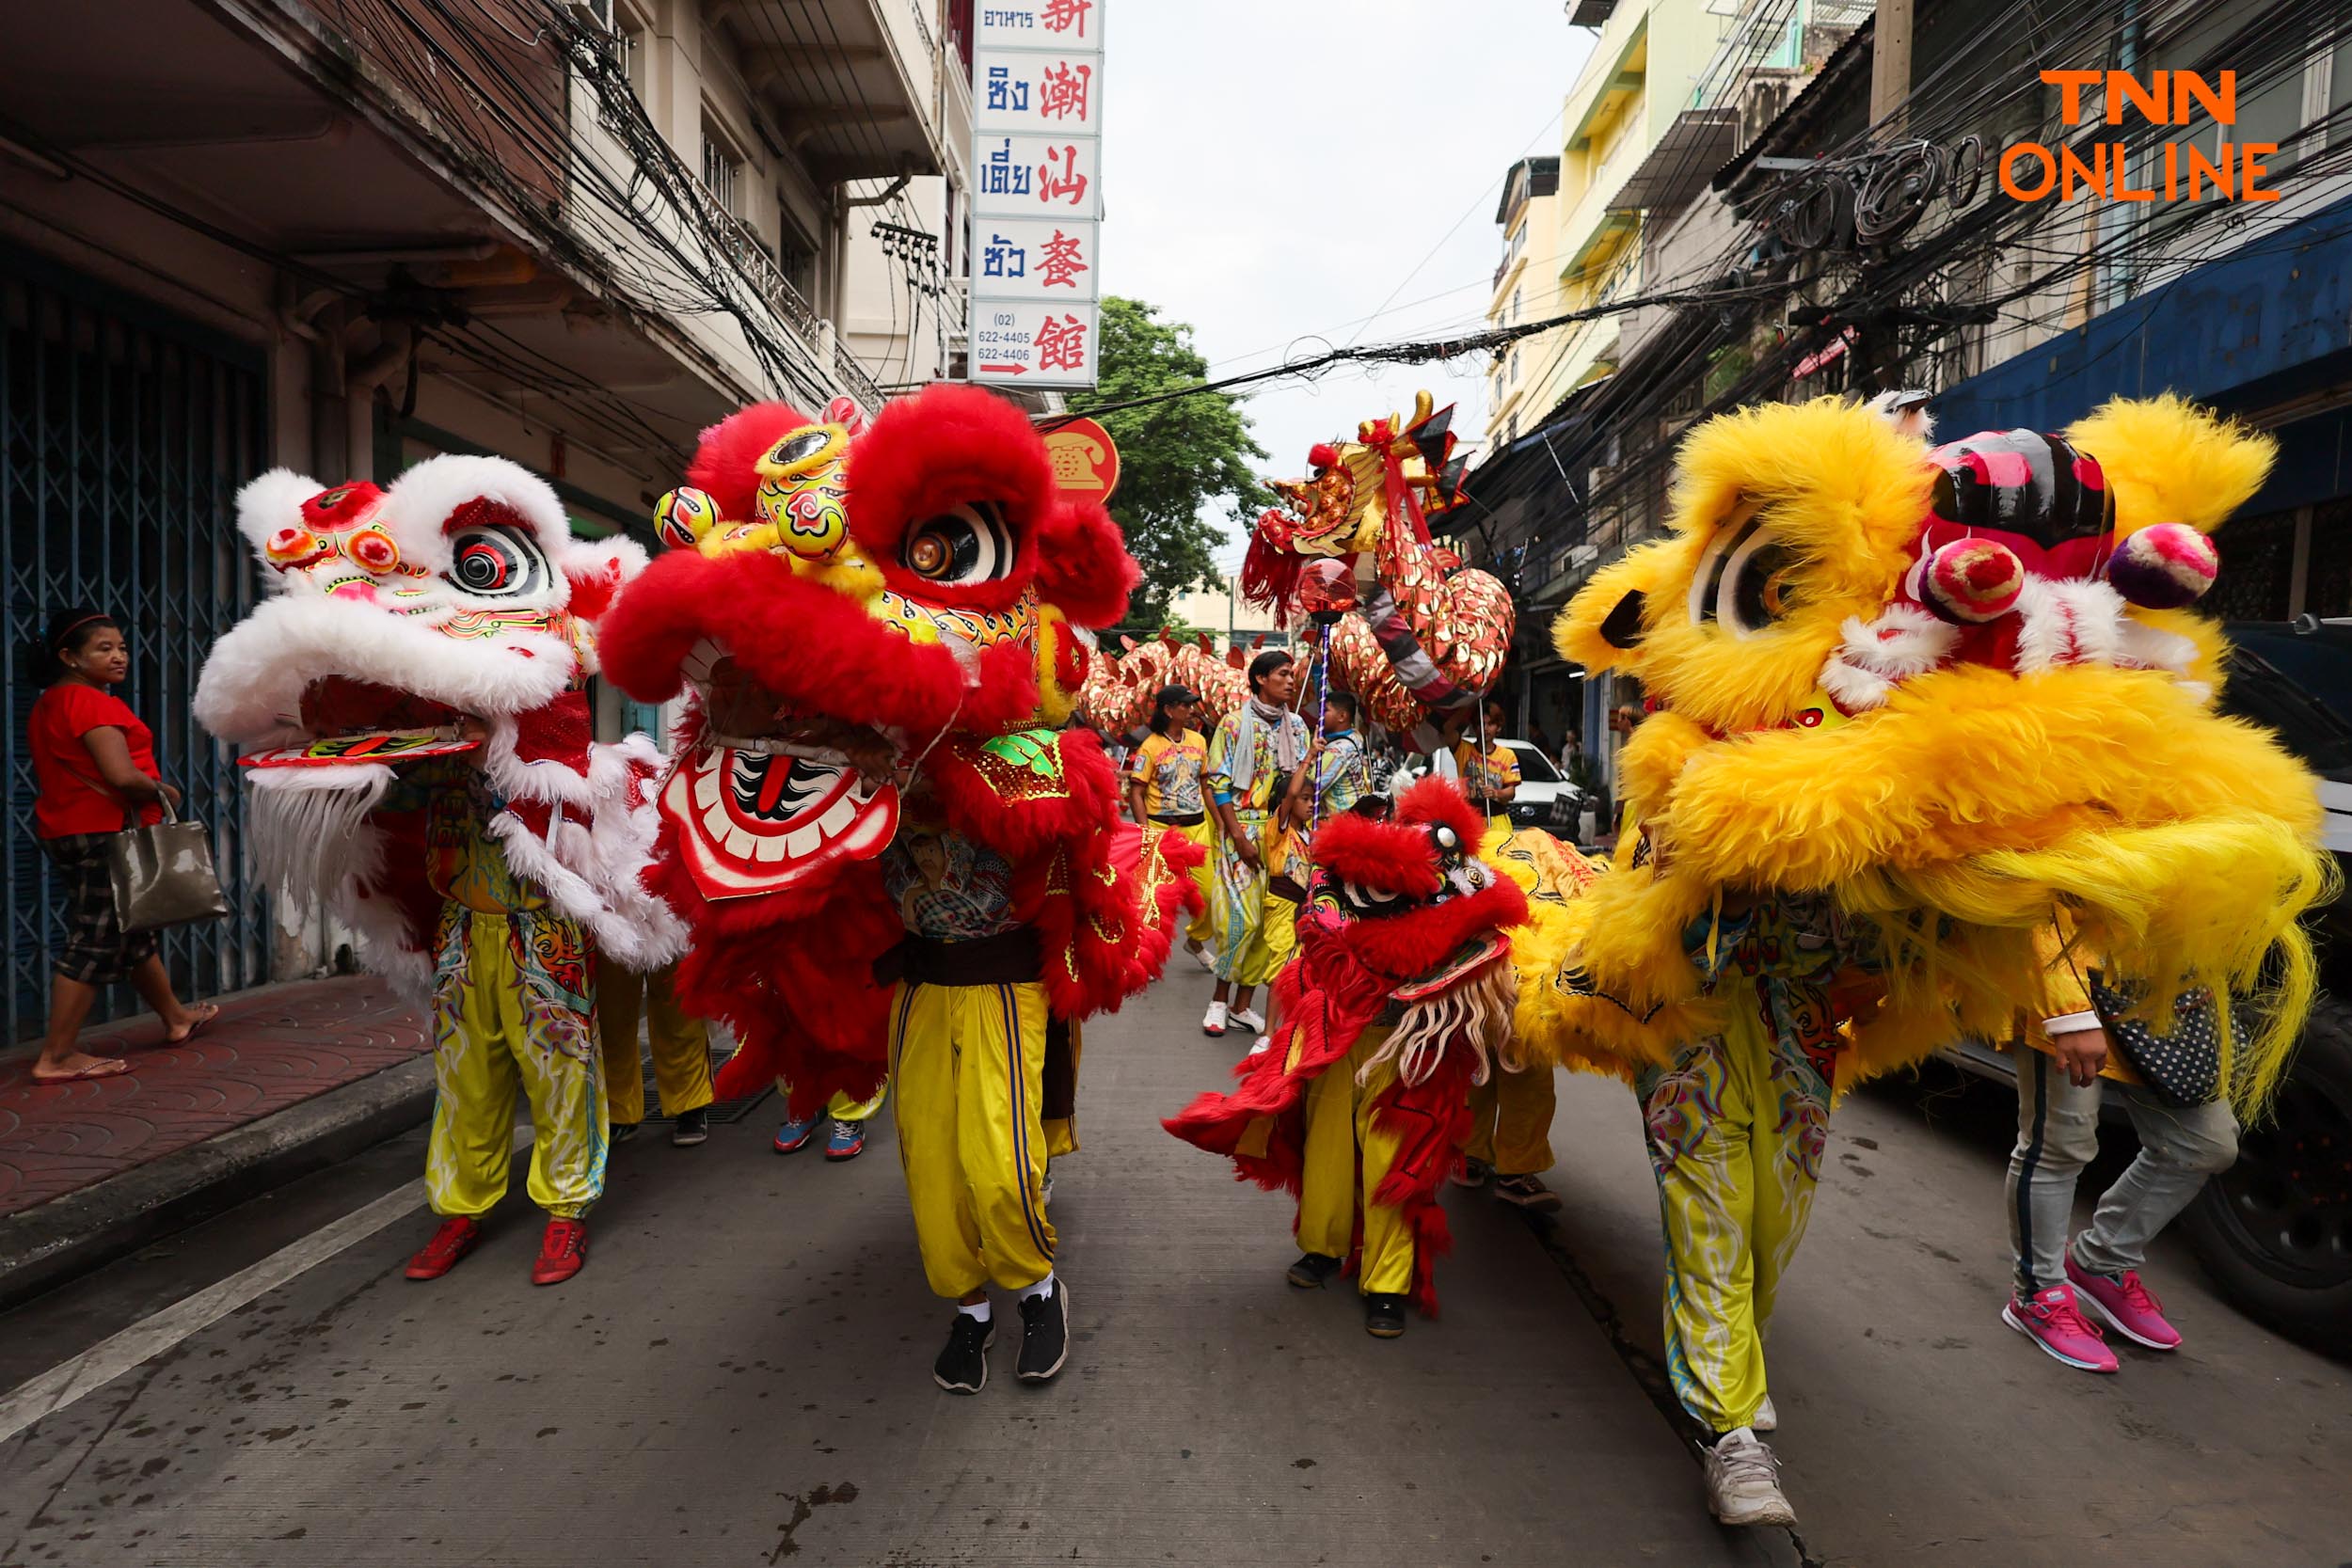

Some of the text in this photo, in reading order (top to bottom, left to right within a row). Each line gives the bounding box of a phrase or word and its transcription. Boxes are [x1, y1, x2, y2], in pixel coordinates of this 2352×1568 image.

[984, 10, 1033, 28] อาหาร
[988, 67, 1029, 111] ซิง
[981, 138, 1031, 195] เตี่ย
[984, 234, 1025, 277] ซัว
[993, 312, 1015, 327] (02)
[978, 331, 1030, 343] 622-4405
[978, 348, 1030, 360] 622-4406
